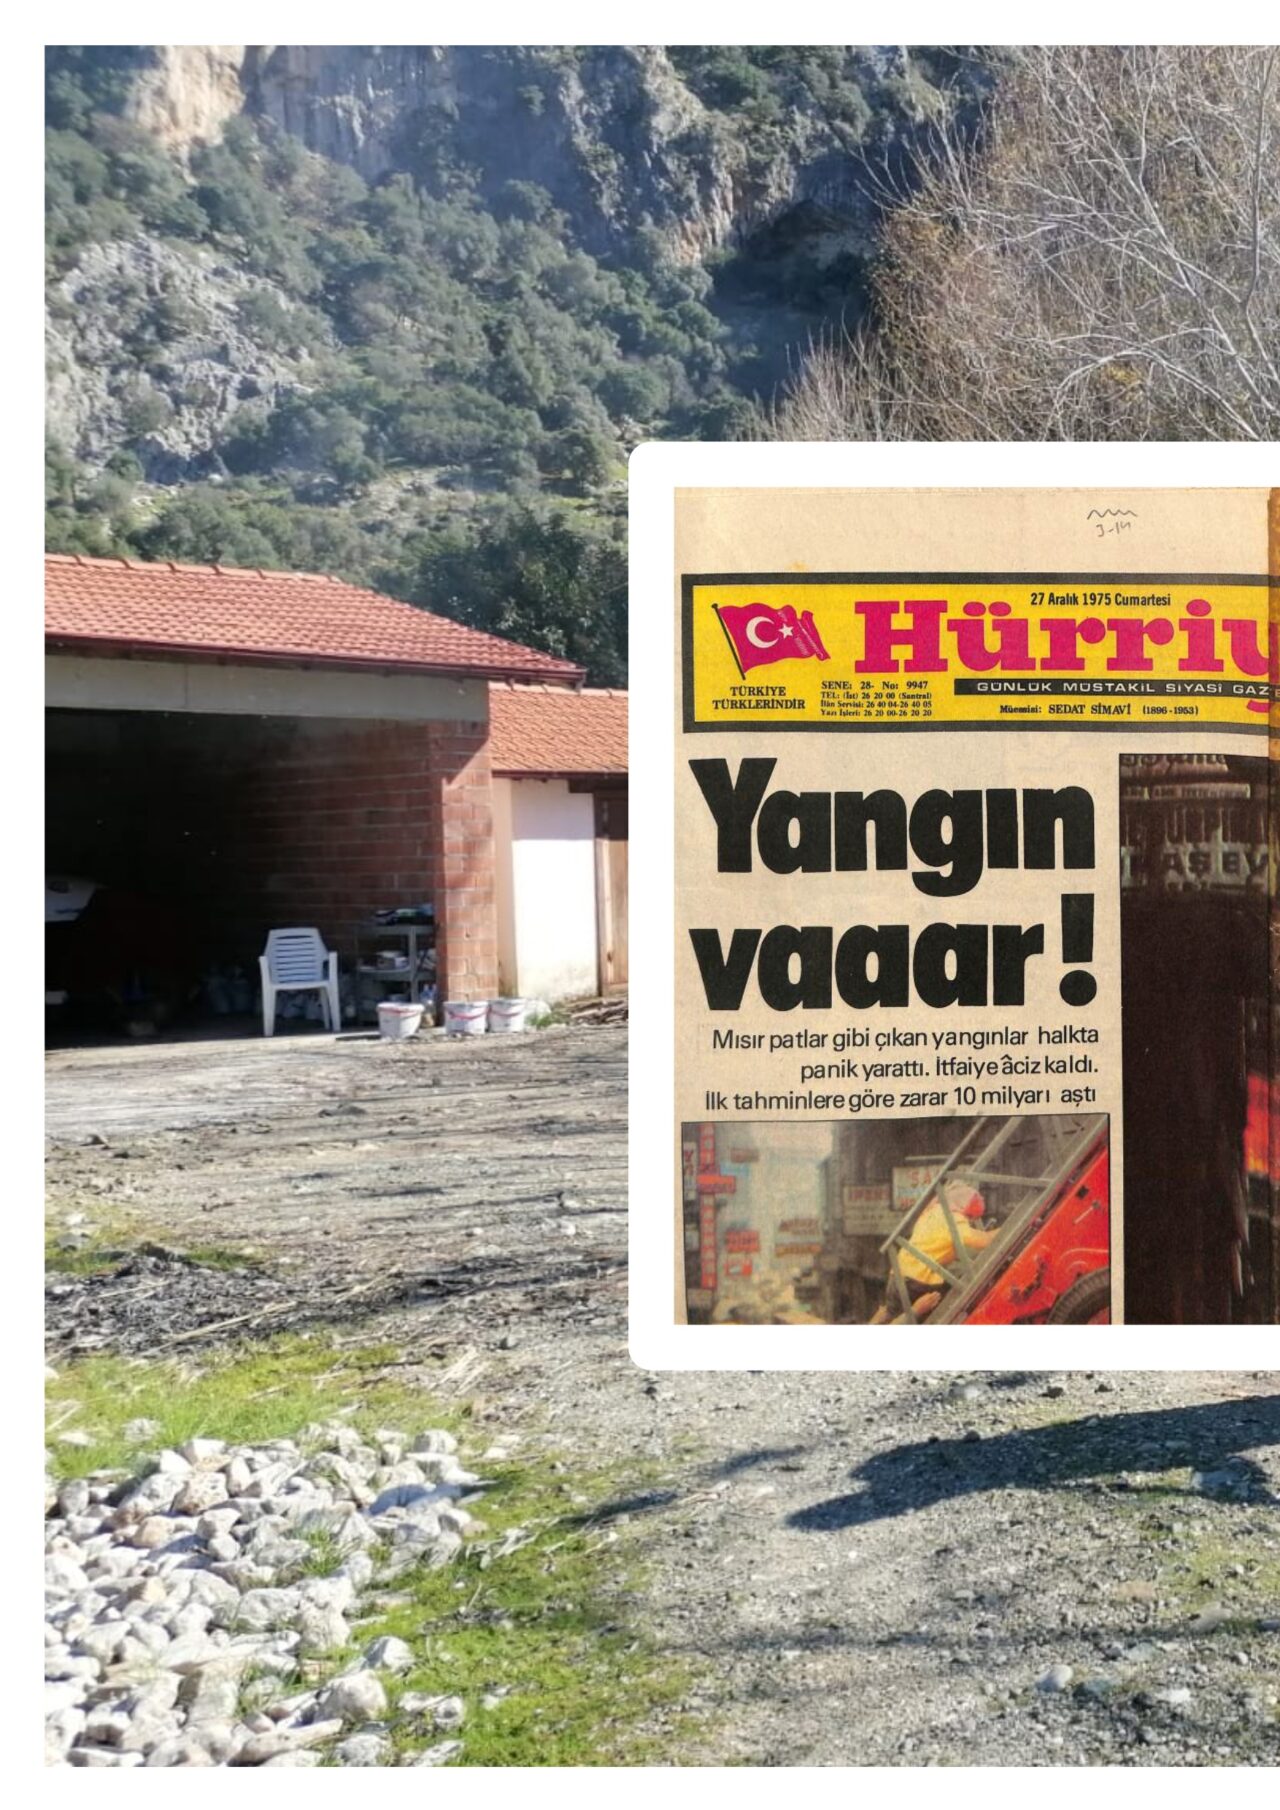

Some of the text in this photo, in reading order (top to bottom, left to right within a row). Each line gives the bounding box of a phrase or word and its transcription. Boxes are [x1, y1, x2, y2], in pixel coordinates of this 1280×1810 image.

[1030, 592, 1171, 606] 27 Aralık 1975 Cumartesi
[821, 680, 928, 690] SENE: 28- No: 9947
[977, 682, 1052, 692] GÜNLÜK
[730, 685, 786, 697] TÜRKİYE
[820, 691, 840, 699] TEL:
[712, 698, 805, 709] TÜRKLERİNDİR
[1048, 704, 1086, 714] SEDAT
[863, 709, 872, 717] 26
[875, 709, 884, 717] 20
[688, 757, 1096, 897] Yangın
[712, 1025, 1099, 1053] Mısır patlar gibi çıkan yangınlar halkta
[801, 1059, 858, 1083] panik
[862, 1060, 930, 1082] yarattı.
[1000, 1054, 1041, 1075] âciz
[1045, 1055, 1099, 1074] kaldı.
[733, 1090, 845, 1110] tahminlere
[849, 1088, 895, 1113] göre
[900, 1091, 948, 1107] zarar
[953, 1086, 976, 1105] 10
[981, 1085, 1050, 1108] milyarı
[1060, 1086, 1096, 1107] aştı
